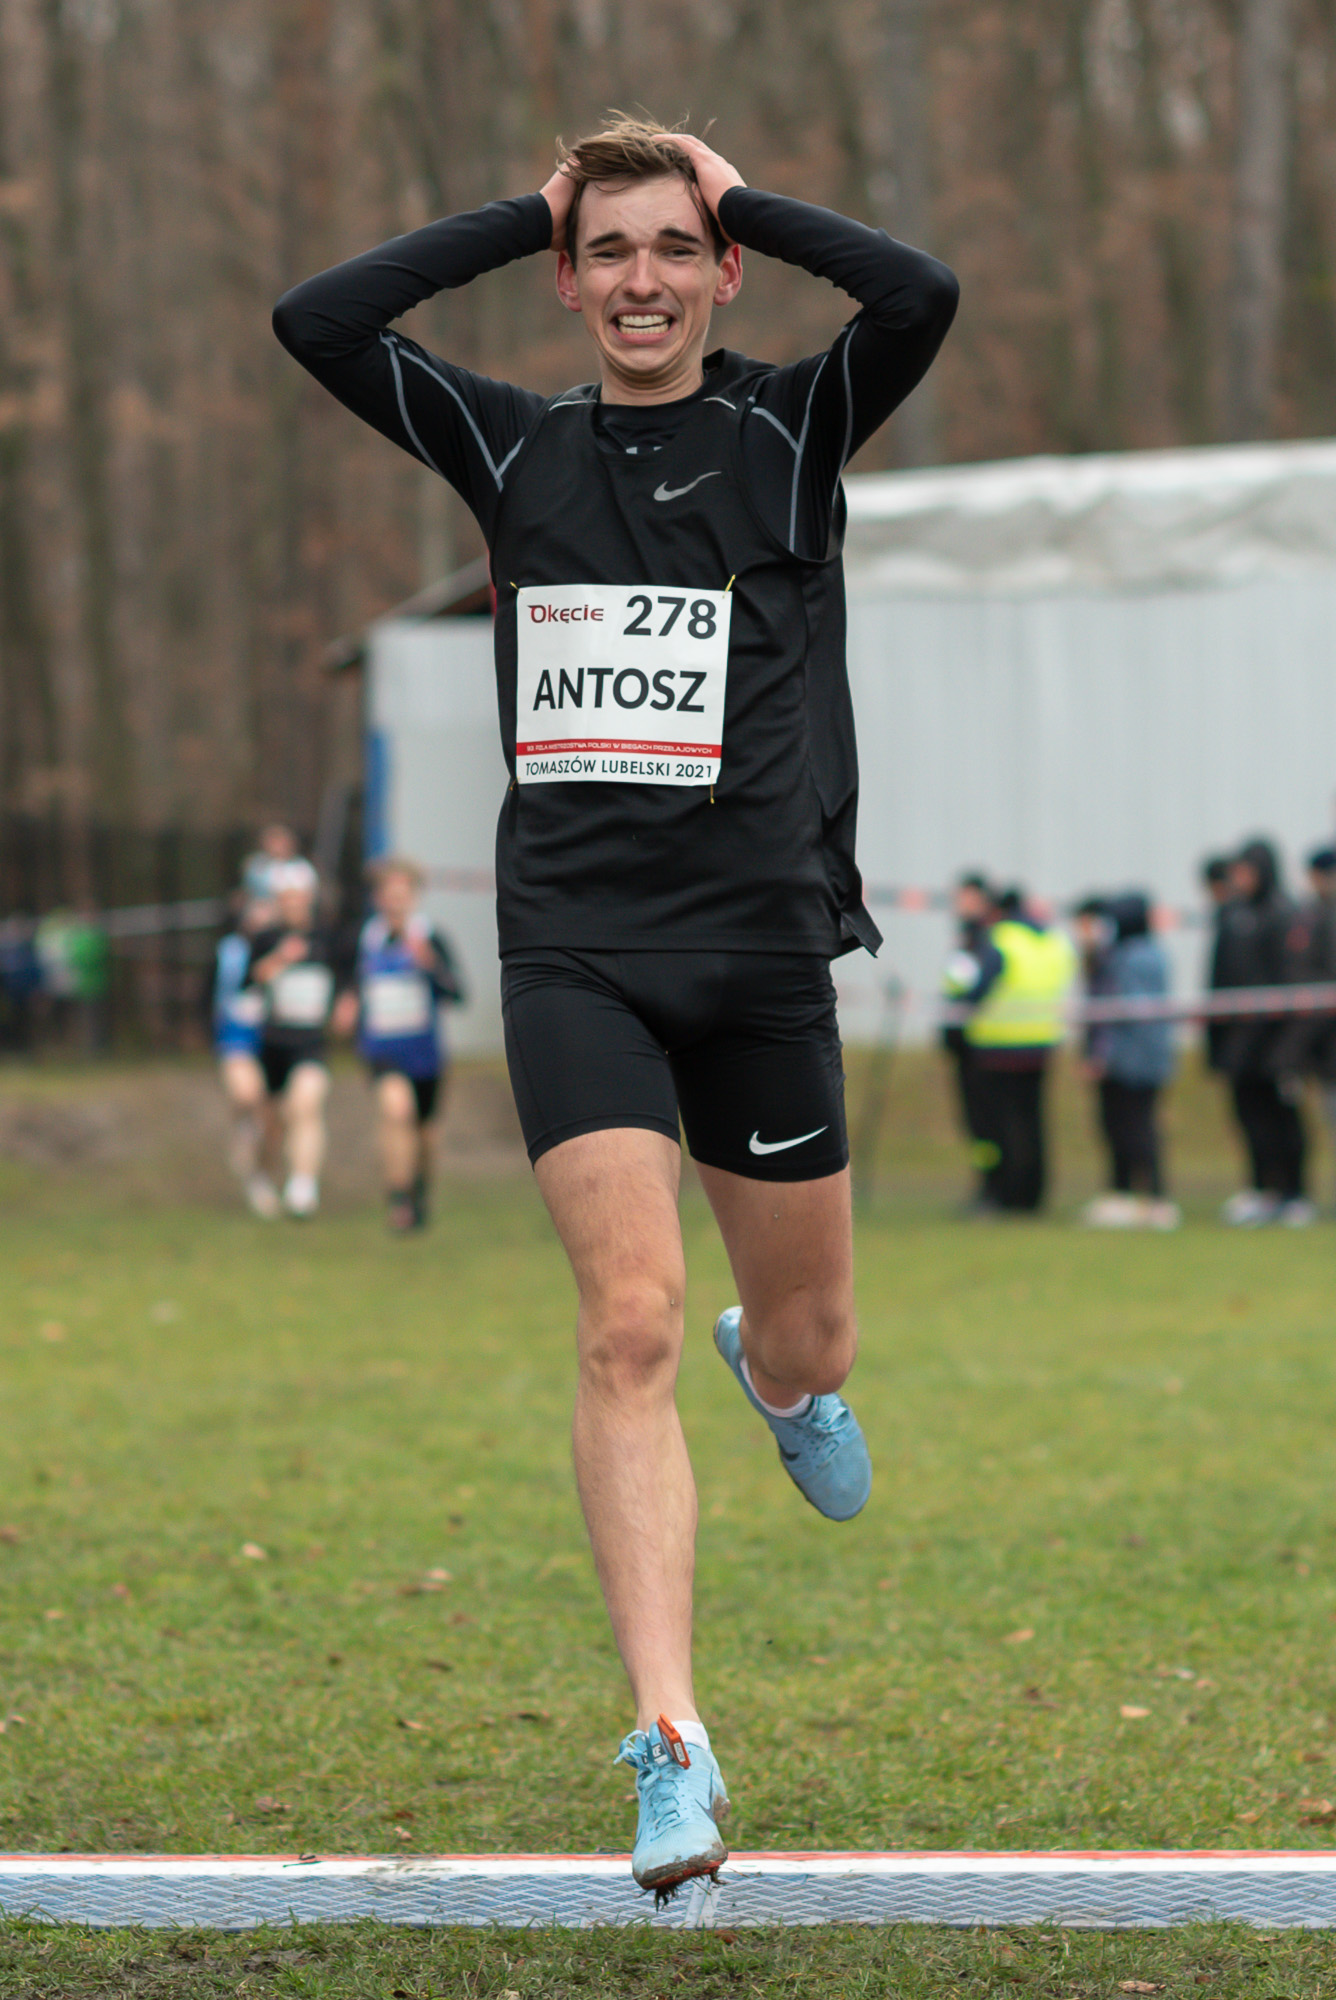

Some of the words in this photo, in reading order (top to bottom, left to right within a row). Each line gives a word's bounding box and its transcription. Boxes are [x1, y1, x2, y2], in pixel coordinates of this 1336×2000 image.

[623, 594, 717, 640] 278
[532, 667, 708, 713] ANTOSZ
[526, 756, 597, 776] TOMASZÓW
[601, 759, 670, 777] LUBELSKI
[675, 763, 712, 778] 2021
